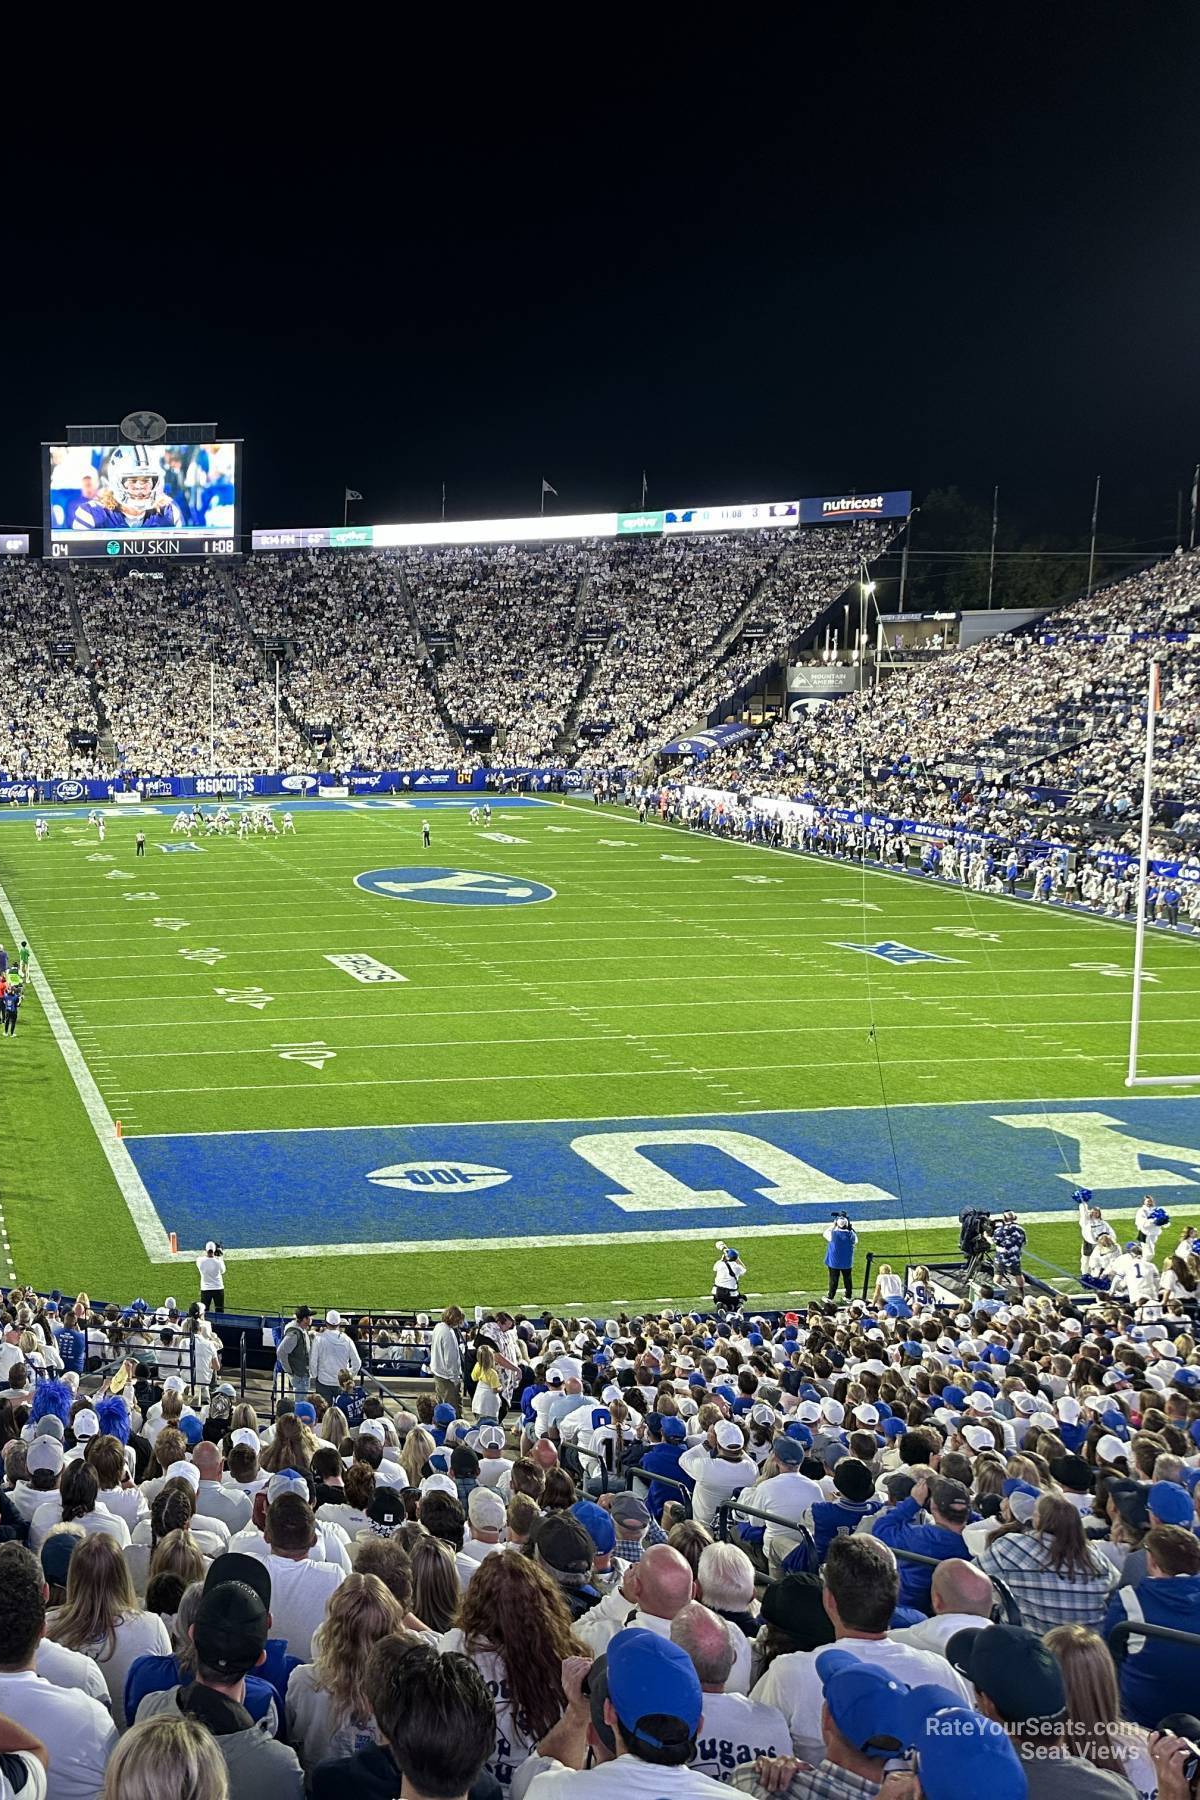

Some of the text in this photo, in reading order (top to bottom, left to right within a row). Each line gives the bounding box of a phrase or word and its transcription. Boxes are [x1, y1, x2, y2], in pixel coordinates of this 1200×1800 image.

[822, 496, 883, 511] nutricost
[52, 544, 68, 556] 04
[124, 540, 180, 554] NU SKIN
[204, 540, 234, 552] 11:08
[458, 774, 472, 784] 04
[915, 824, 934, 834] BYU
[213, 986, 275, 1003] 20
[271, 1041, 337, 1060] 10
[404, 1168, 476, 1185] 100
[1134, 1262, 1143, 1278] 1
[689, 1738, 776, 1768] ugars
